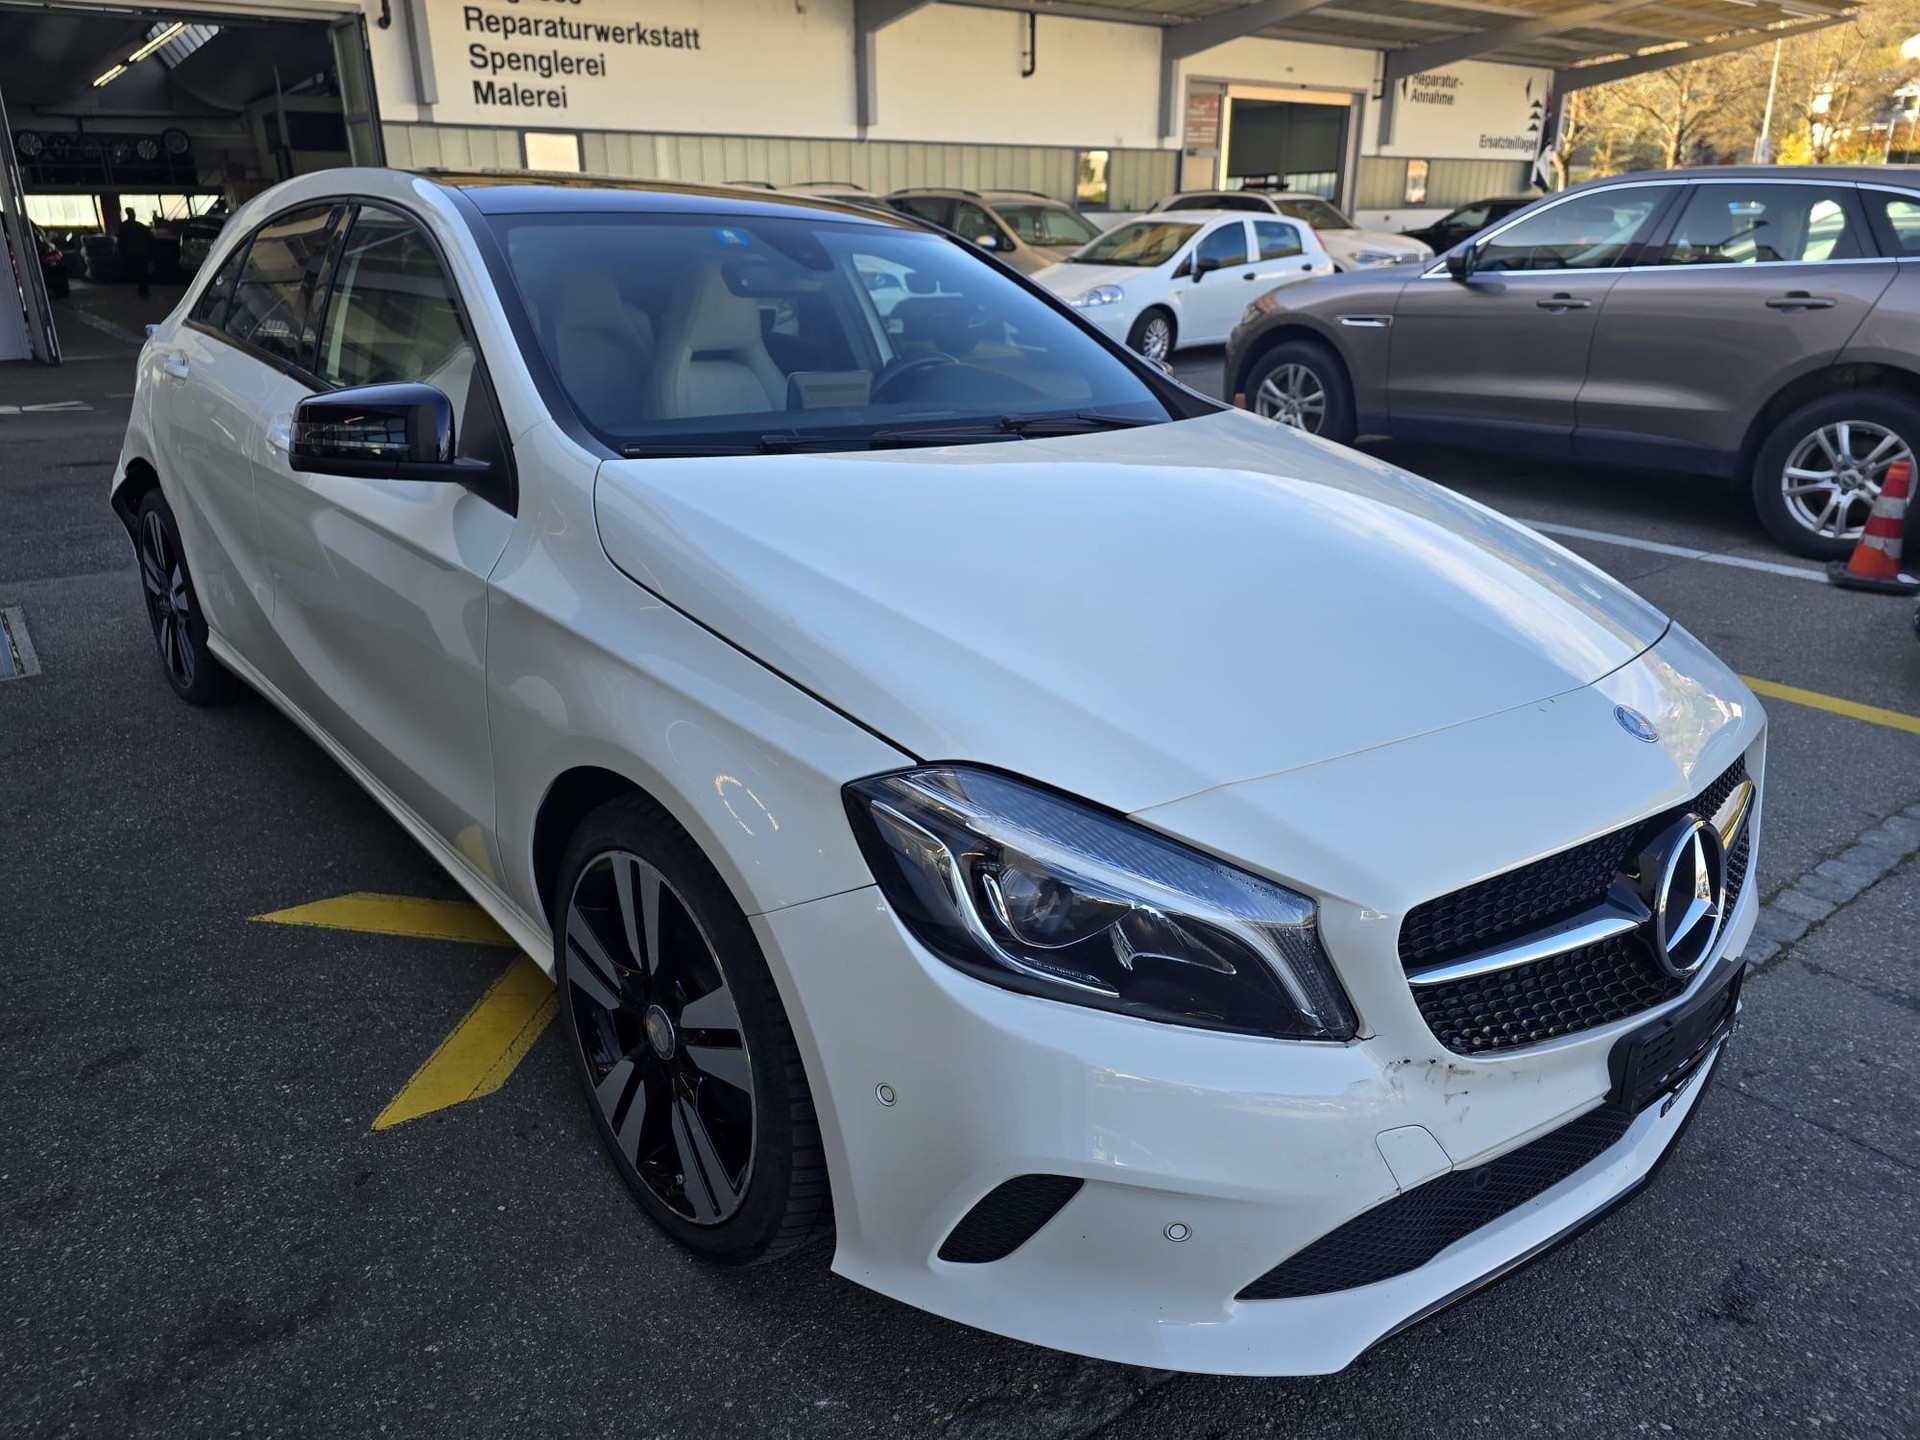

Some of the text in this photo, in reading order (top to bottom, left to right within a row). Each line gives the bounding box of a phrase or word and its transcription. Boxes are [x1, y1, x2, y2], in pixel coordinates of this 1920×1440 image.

[463, 6, 701, 50] Reparaturwerkstatt
[469, 44, 606, 78] Spenglerei
[473, 80, 568, 108] Malerei
[1411, 88, 1454, 106] Annahme
